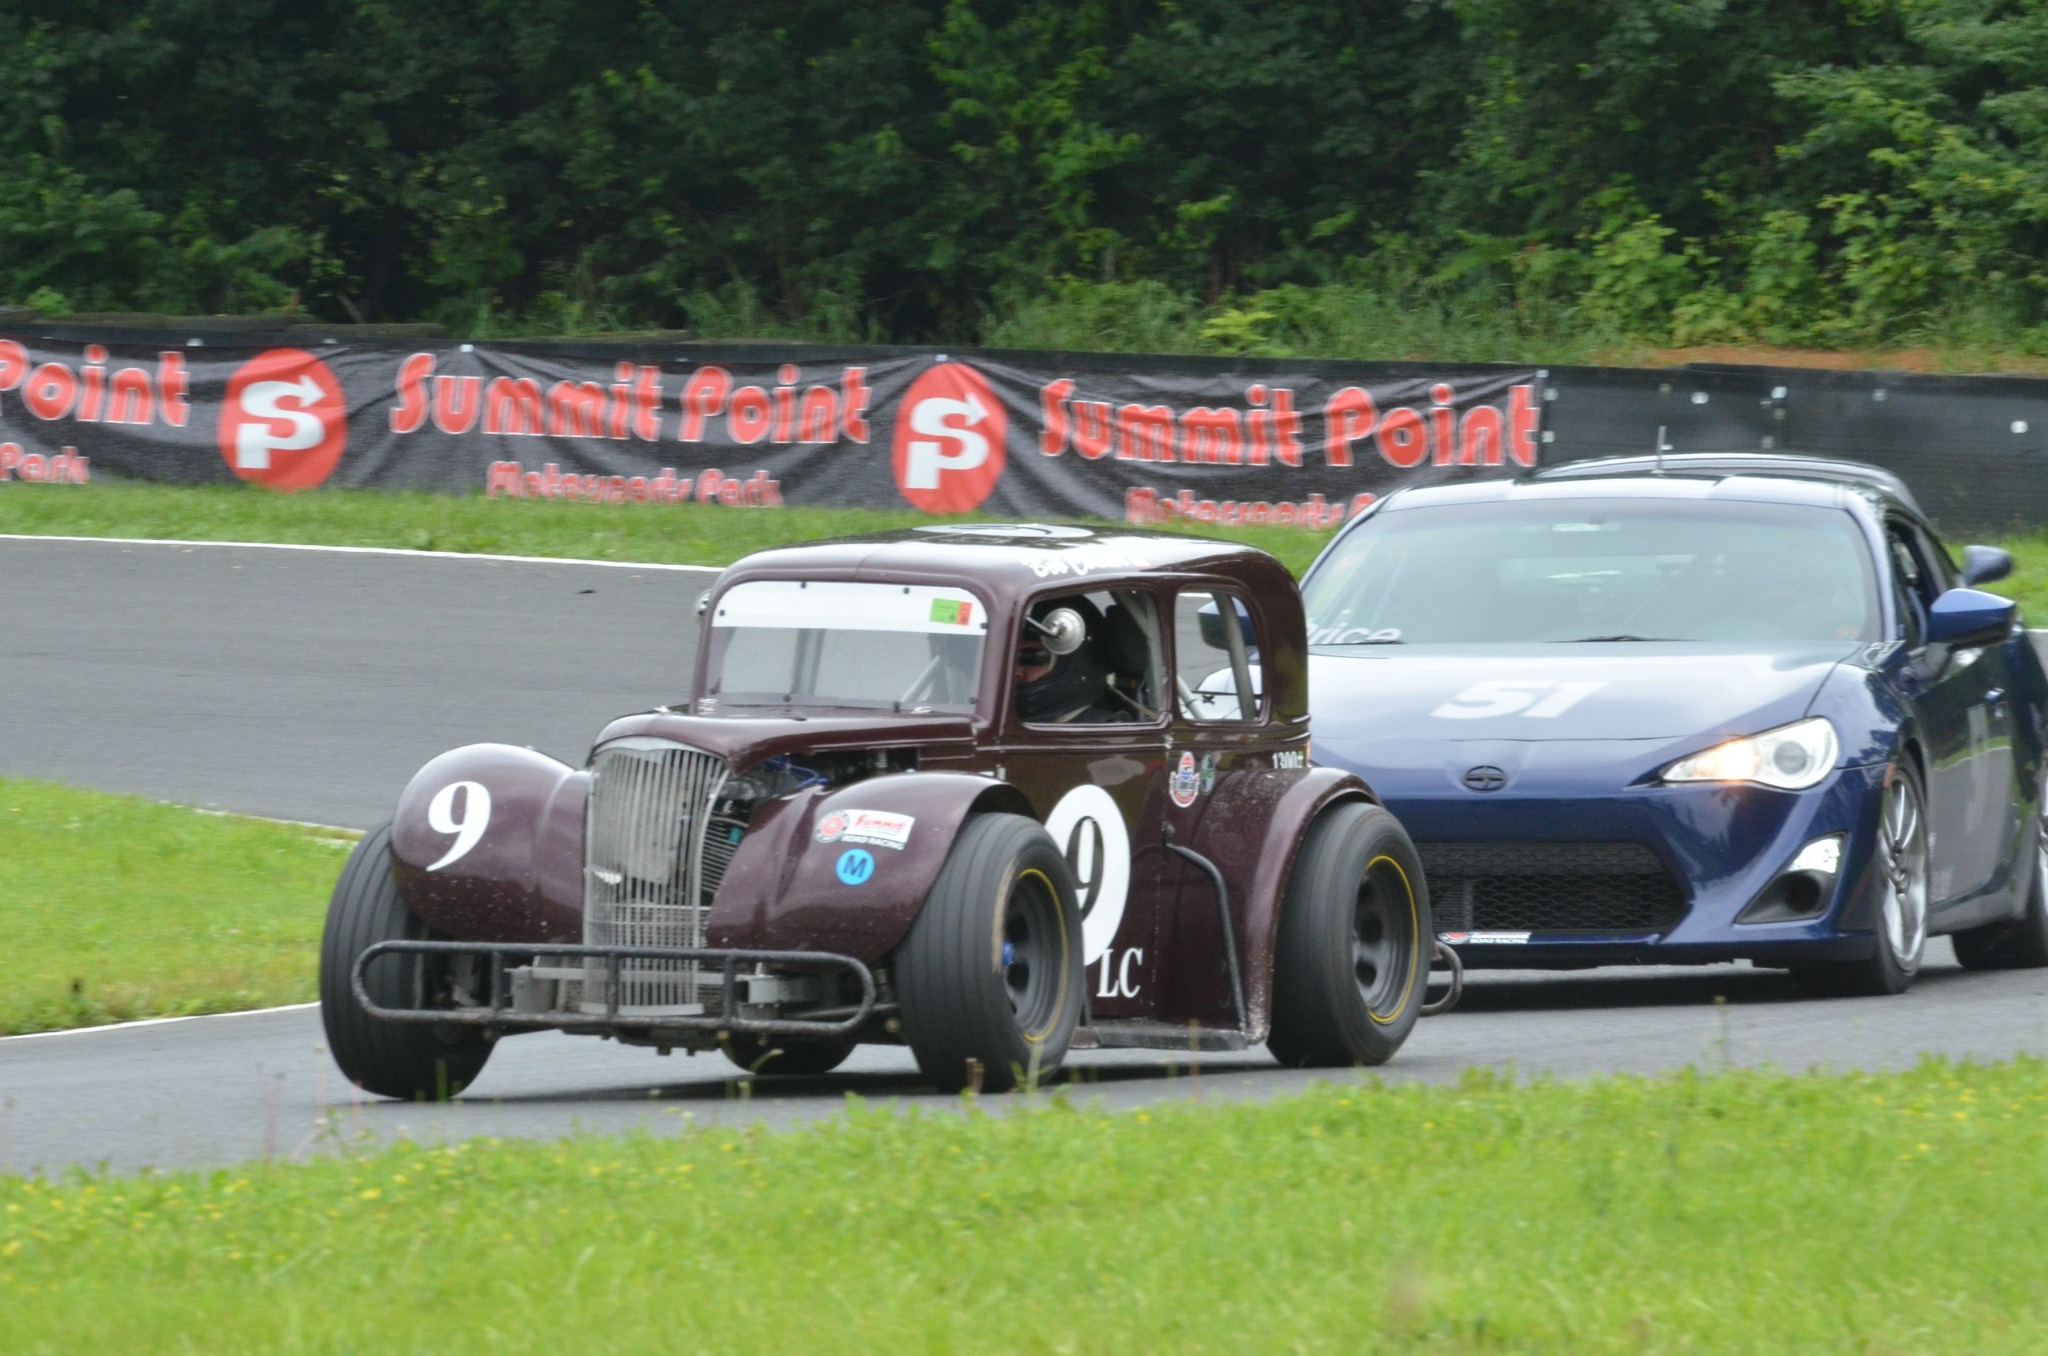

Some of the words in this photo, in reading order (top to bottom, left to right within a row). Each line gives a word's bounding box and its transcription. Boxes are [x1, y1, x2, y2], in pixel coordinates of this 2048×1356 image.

[390, 353, 662, 441] Summit
[677, 364, 872, 444] Point
[1039, 378, 1303, 467] Summit
[1323, 383, 1540, 468] Point
[0, 442, 90, 484] Park
[695, 468, 784, 508] Park
[1429, 680, 1611, 720] 51
[425, 780, 491, 872] 9
[842, 854, 869, 879] M
[1065, 815, 1105, 923] 9
[1096, 947, 1144, 998] LC
